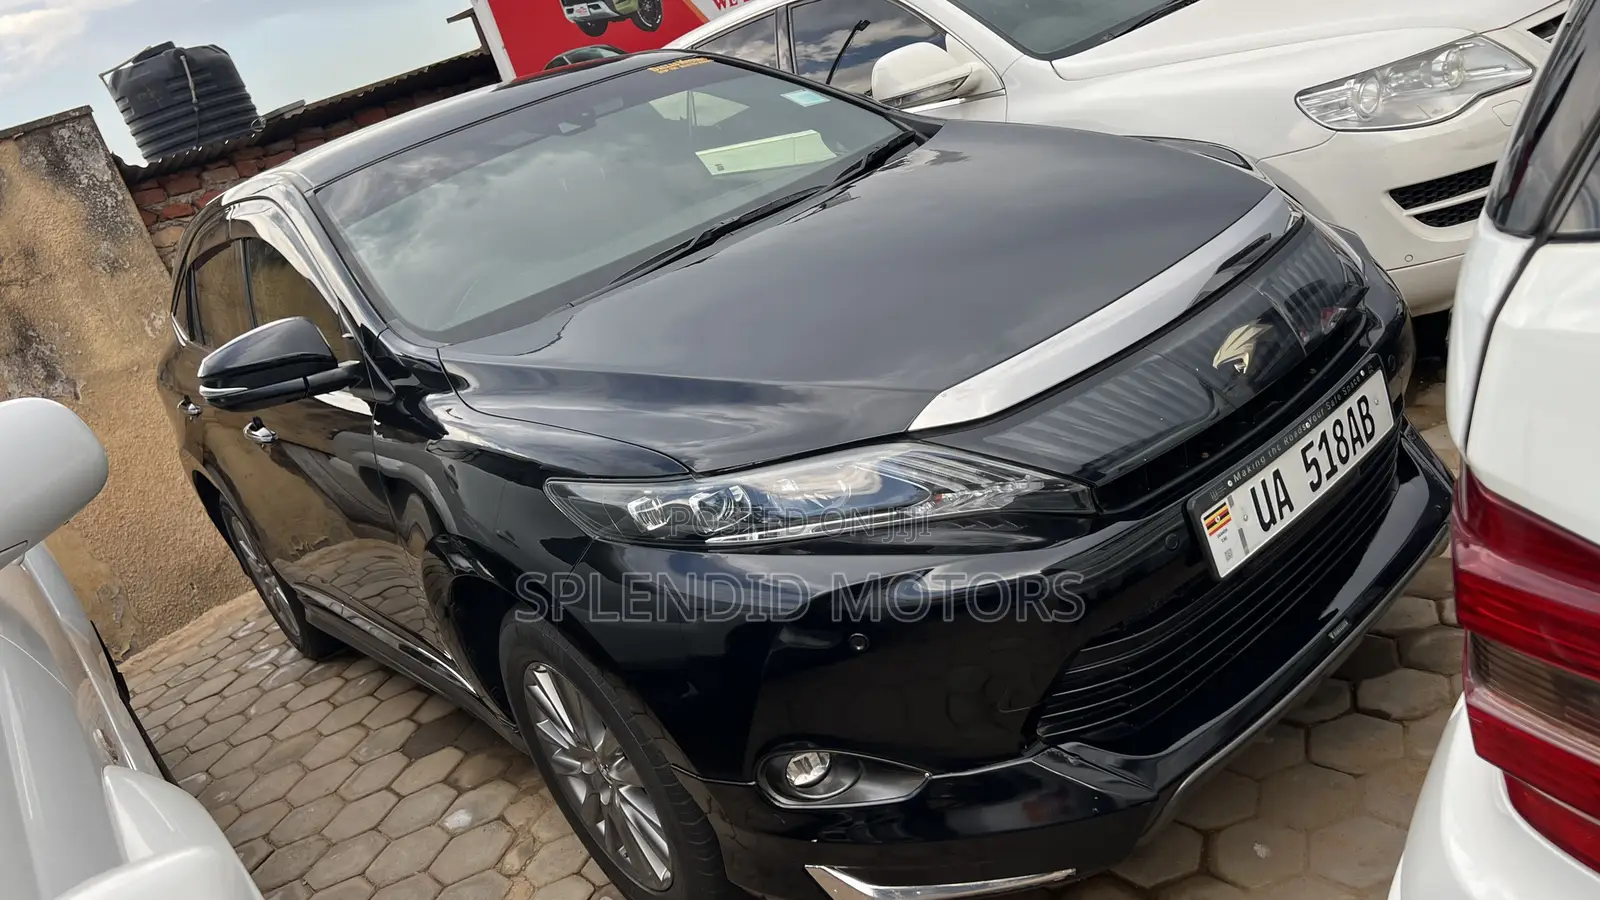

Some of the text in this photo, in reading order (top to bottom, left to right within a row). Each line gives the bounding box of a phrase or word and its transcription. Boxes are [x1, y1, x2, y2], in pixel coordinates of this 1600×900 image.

[1233, 456, 1266, 483] Making
[1325, 393, 1342, 410] Safe
[1341, 375, 1361, 396] Space
[1249, 394, 1376, 533] UA 518AB
